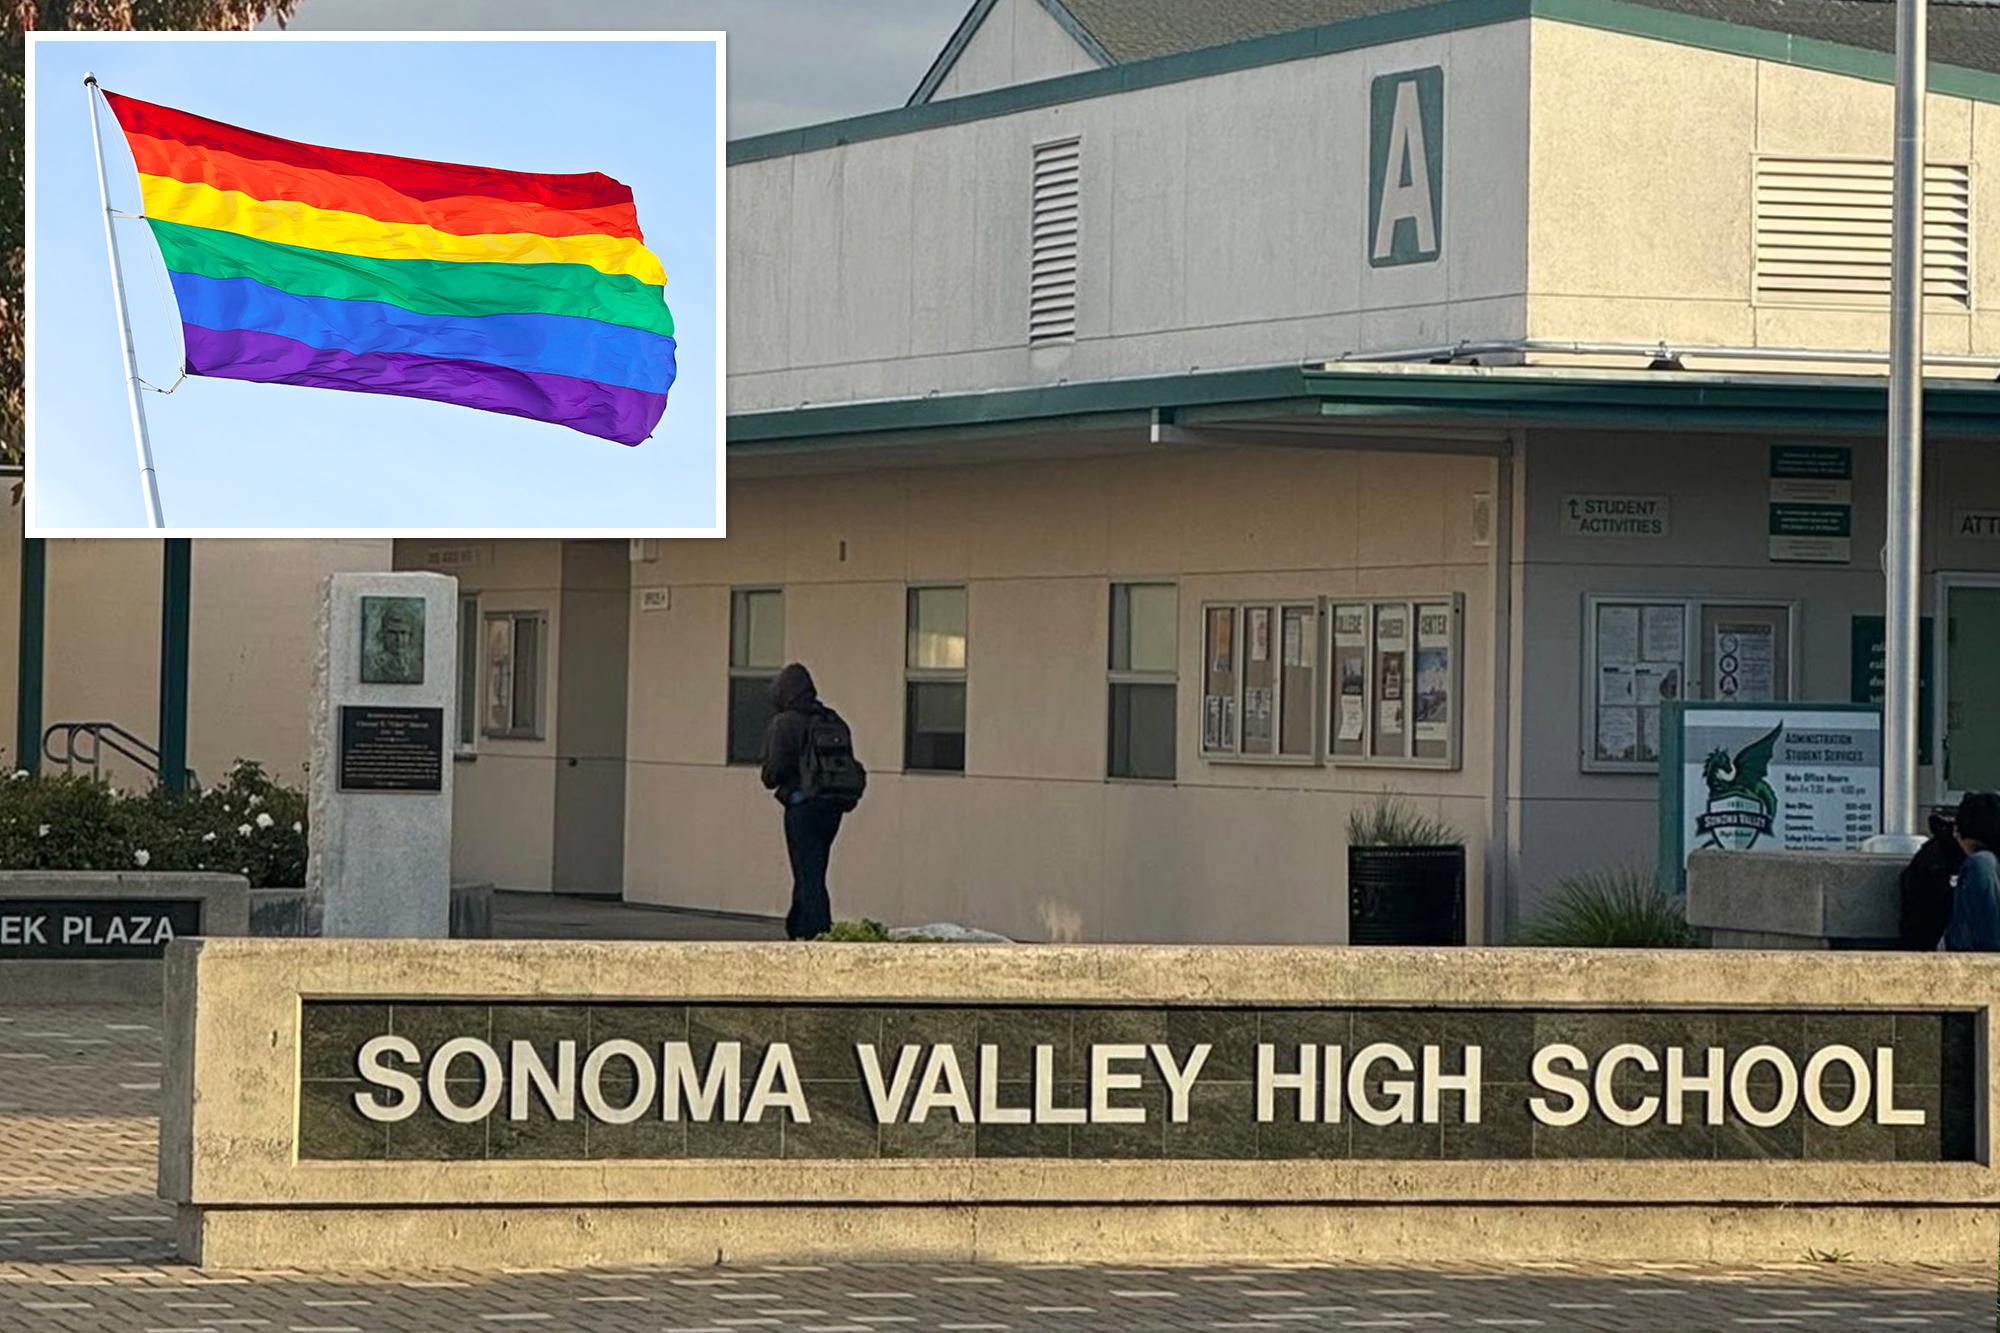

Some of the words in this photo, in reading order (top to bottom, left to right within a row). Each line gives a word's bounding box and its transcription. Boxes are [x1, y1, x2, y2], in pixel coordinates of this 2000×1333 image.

[1374, 80, 1437, 260] A
[1585, 499, 1657, 515] STUDENT
[1579, 518, 1663, 535] ACTIVITIES
[1960, 515, 2000, 535] ATT
[1784, 748, 1822, 761] STUDENT
[1823, 748, 1864, 763] SERVICES
[0, 916, 48, 945] EK
[62, 916, 175, 945] PLAZA
[354, 1034, 812, 1125] SONOMA
[855, 1042, 1213, 1126] VALLEY
[1256, 1042, 1483, 1127] HIGH
[1529, 1042, 1926, 1128] SCHOOL
